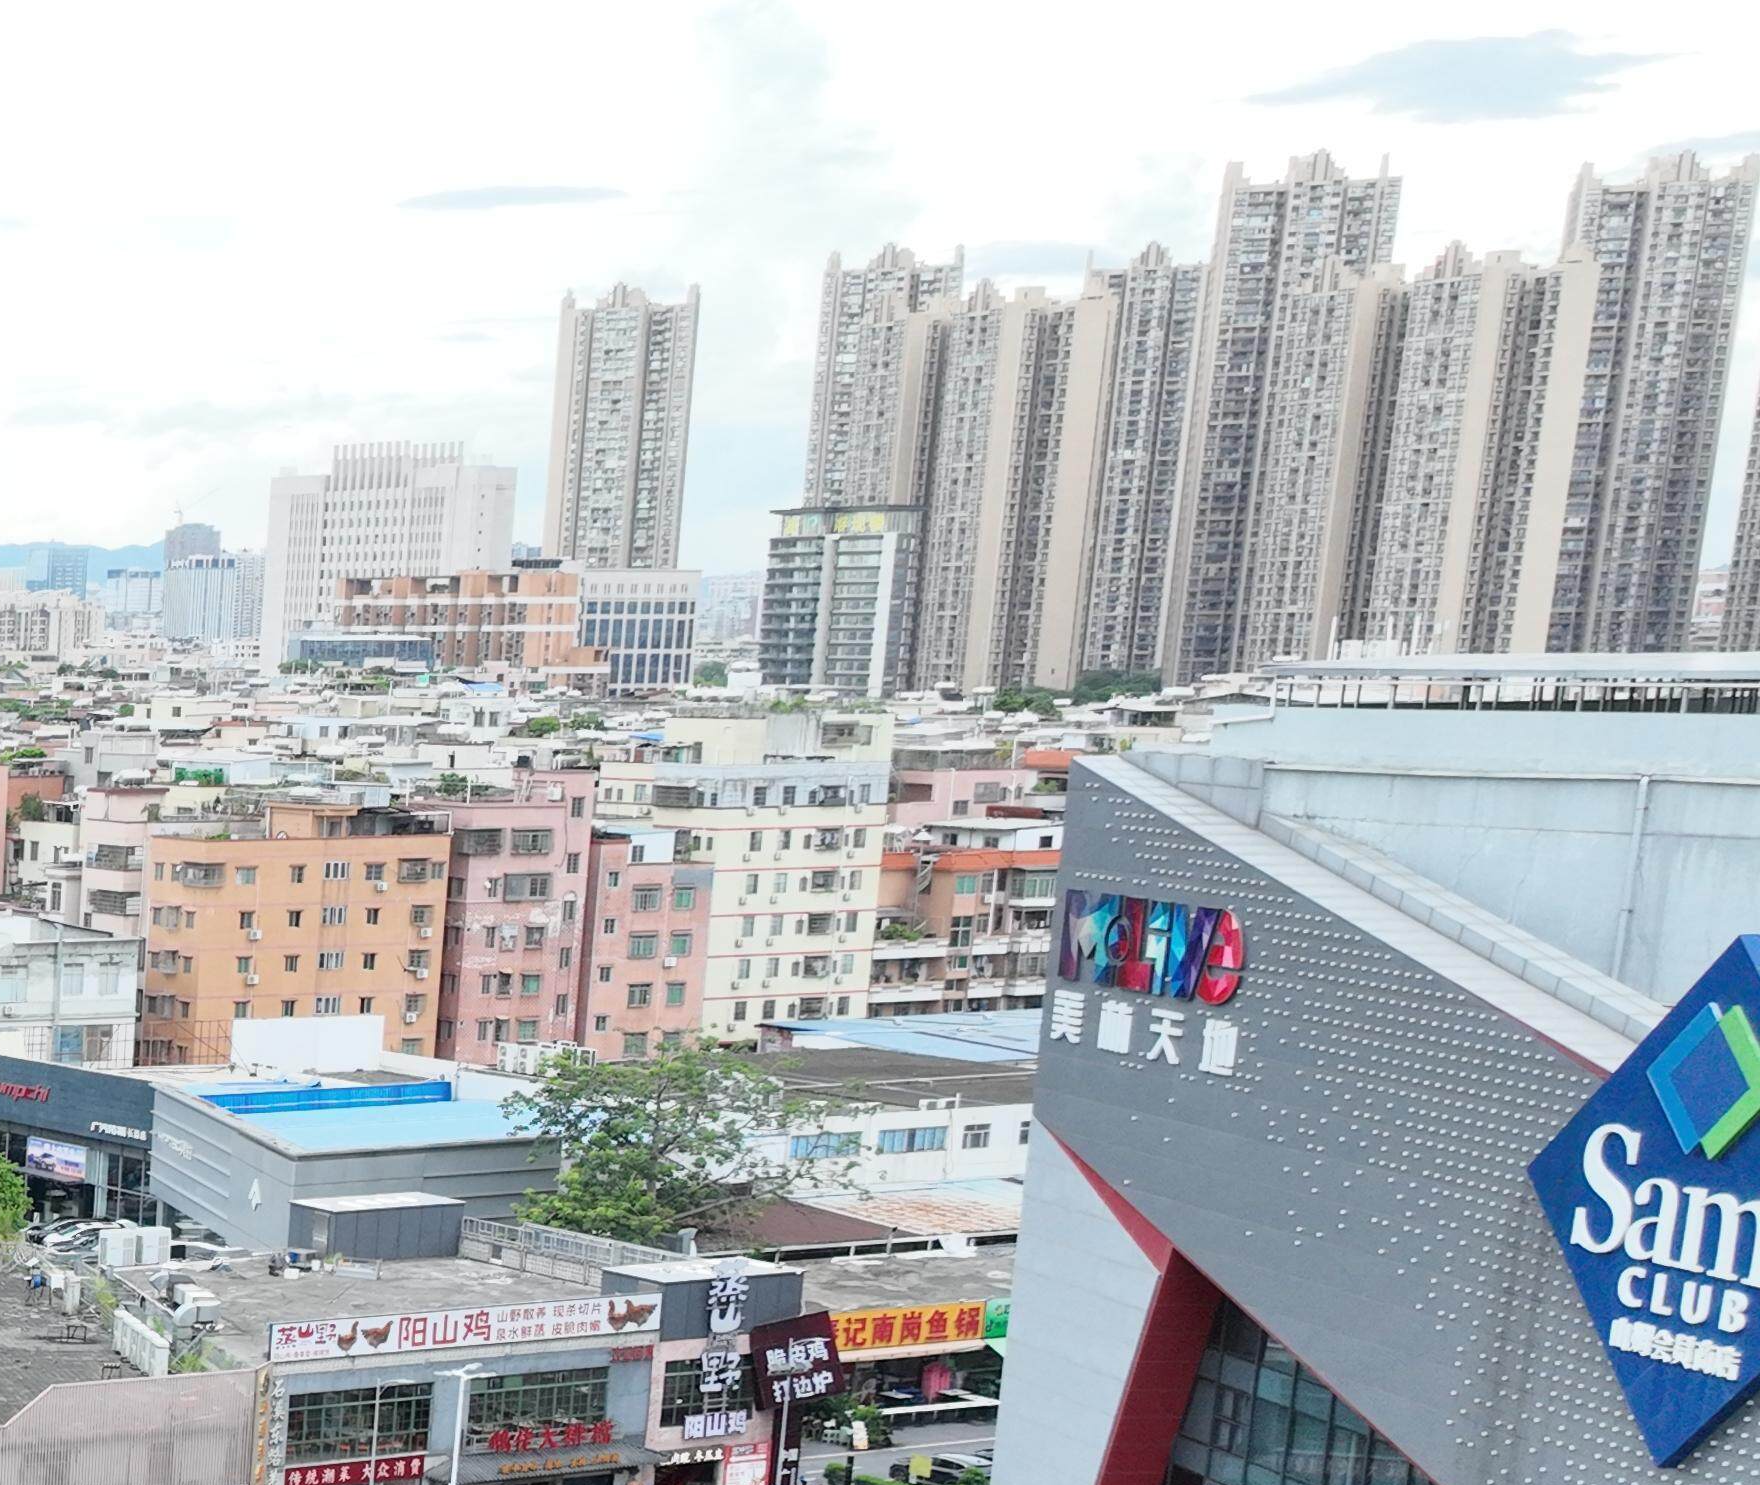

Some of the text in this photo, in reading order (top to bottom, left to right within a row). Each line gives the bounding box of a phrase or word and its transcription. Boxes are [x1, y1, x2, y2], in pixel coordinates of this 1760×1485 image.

[1617, 1266, 1749, 1333] CLUB
[397, 1310, 491, 1350] 阳山鸡
[772, 1370, 834, 1403] 打边炉
[684, 1410, 747, 1441] 阳山鸡
